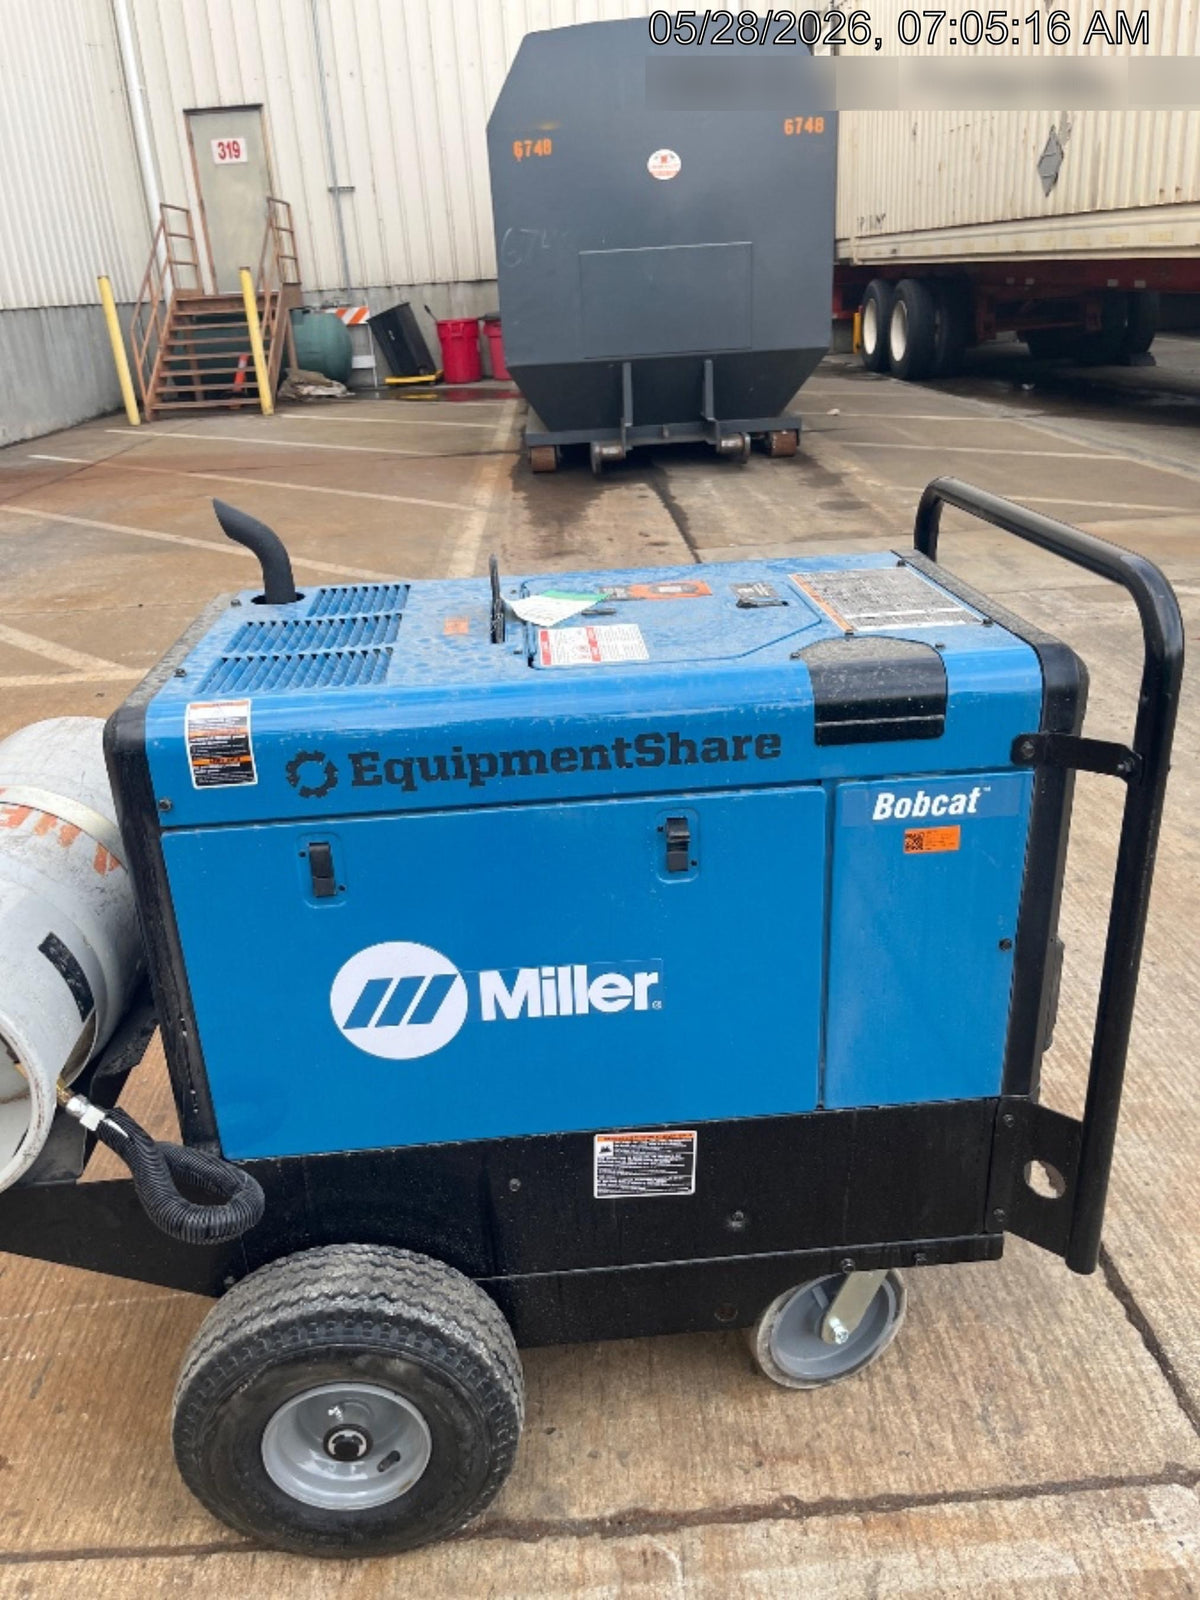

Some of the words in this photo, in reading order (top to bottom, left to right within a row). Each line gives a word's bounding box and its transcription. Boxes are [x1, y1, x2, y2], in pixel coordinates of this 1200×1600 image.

[783, 116, 825, 136] 6748
[217, 140, 241, 160] 319
[348, 731, 782, 792] EquipmentShare
[479, 964, 659, 1021] Miller
